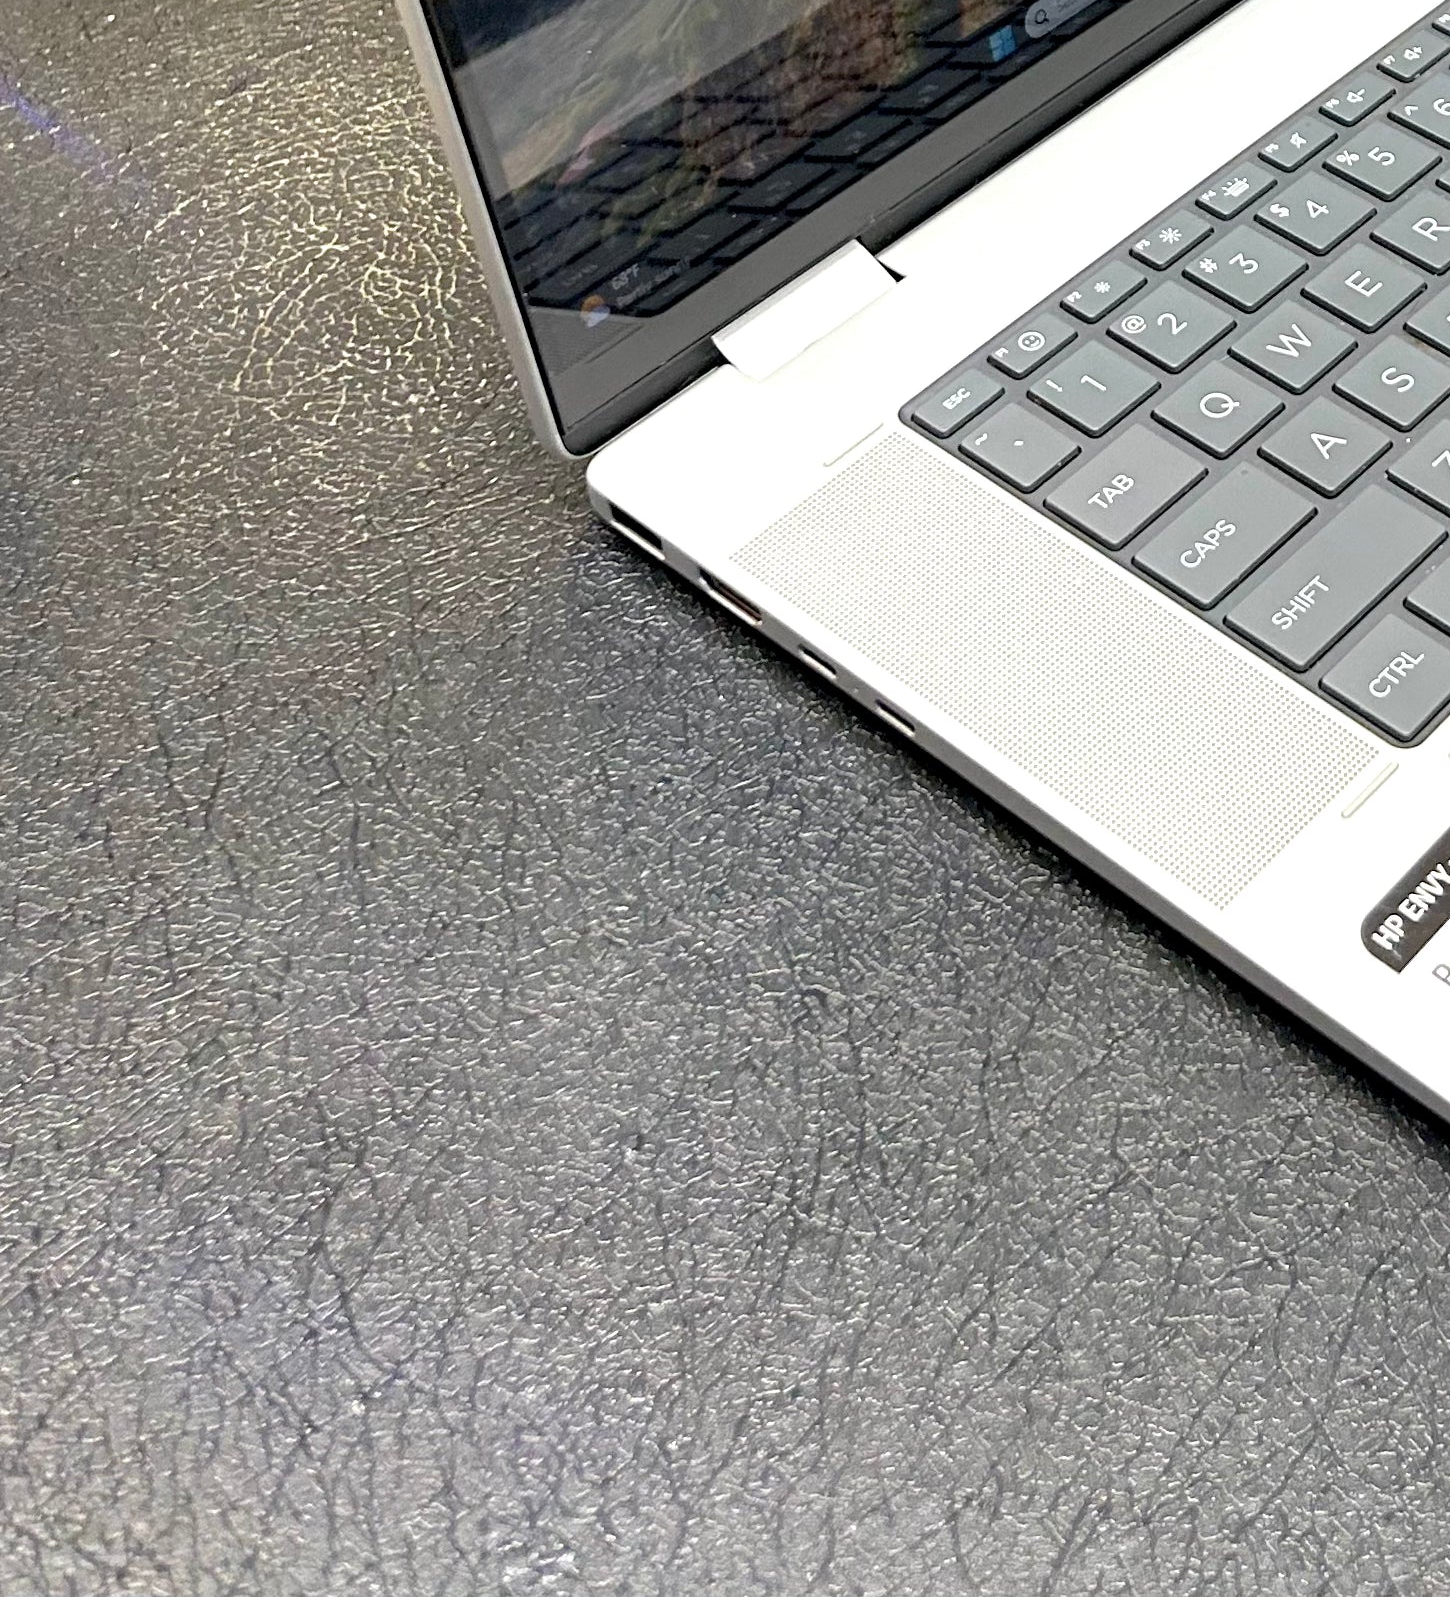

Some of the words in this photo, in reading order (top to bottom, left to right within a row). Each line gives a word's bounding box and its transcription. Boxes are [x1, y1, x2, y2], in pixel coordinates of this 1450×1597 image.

[1367, 146, 1396, 166] 5
[1306, 199, 1330, 219] 4
[1411, 217, 1450, 242] R
[1228, 252, 1259, 275] 3
[1344, 270, 1383, 298] E
[1157, 312, 1188, 335] 2
[1265, 323, 1312, 358] W
[1080, 375, 1107, 392] 1
[1381, 367, 1415, 393] S
[942, 387, 971, 410] ESC
[1199, 392, 1240, 419] Q
[1310, 432, 1348, 460] A
[1087, 474, 1135, 509] TAB
[1180, 519, 1236, 569] CAPS
[1271, 574, 1330, 630] SHIFT
[1368, 651, 1425, 698] CTRL
[1371, 913, 1406, 951] HP
